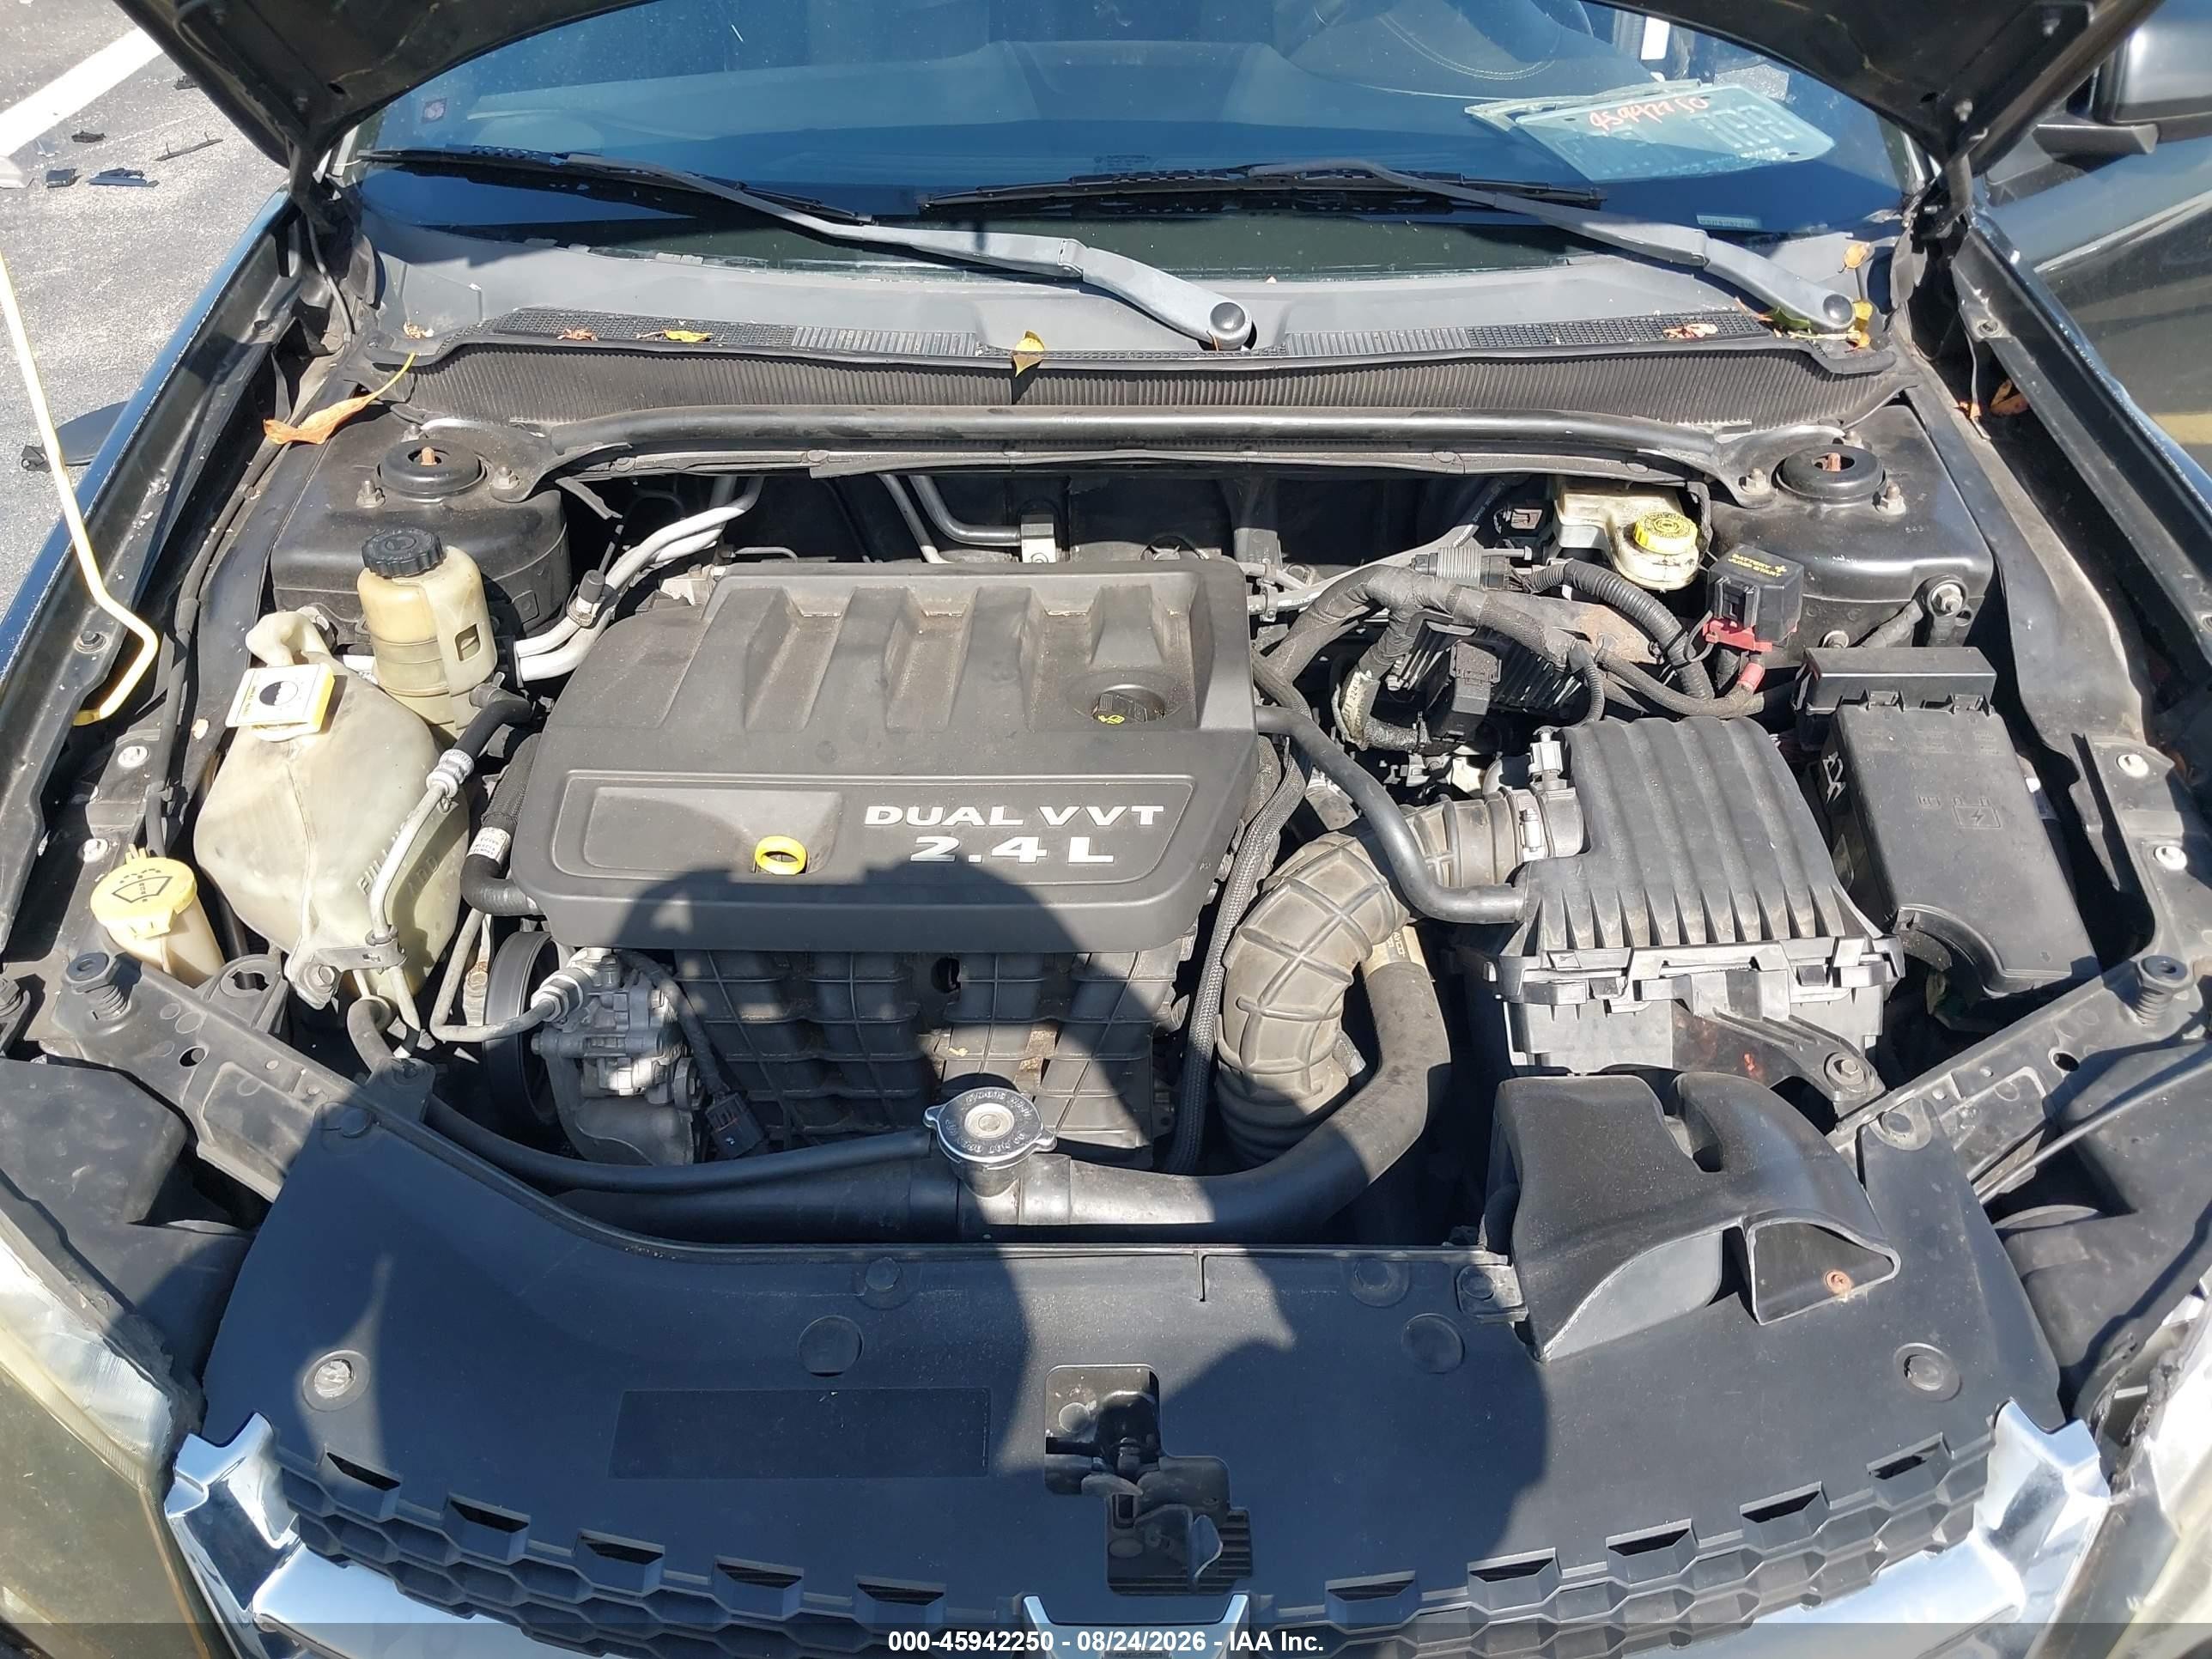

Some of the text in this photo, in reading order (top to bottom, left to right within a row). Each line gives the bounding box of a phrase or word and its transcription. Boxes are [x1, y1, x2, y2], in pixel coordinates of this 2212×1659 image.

[864, 805, 1164, 827] DUAL VVT
[909, 836, 1115, 864] 2.4 L
